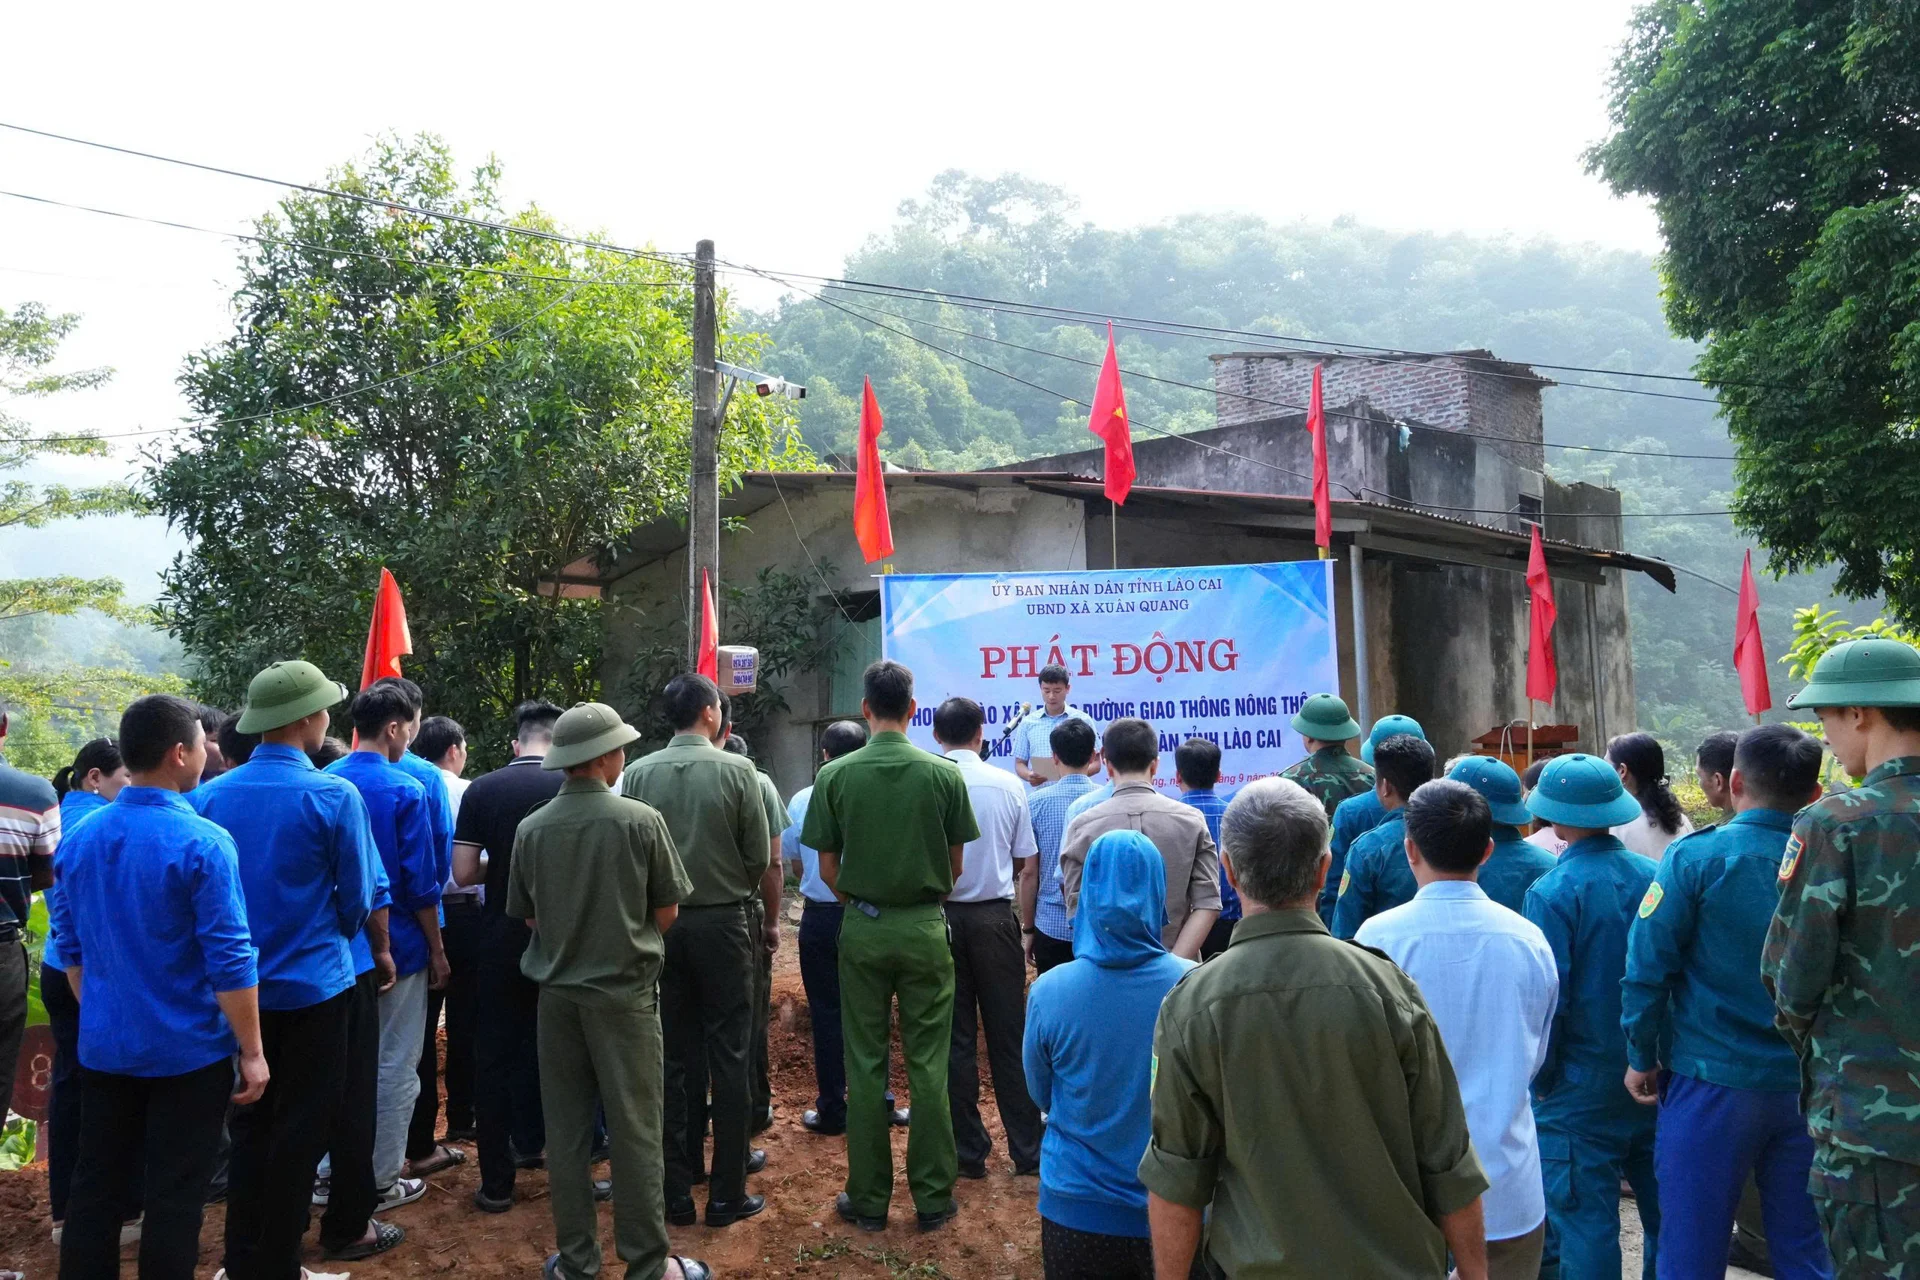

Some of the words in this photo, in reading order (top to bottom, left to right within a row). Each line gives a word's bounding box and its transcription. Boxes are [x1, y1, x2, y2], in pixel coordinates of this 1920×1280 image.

[992, 580, 1011, 597] ỦY
[1015, 585, 1045, 596] BAN
[1048, 580, 1090, 596] NHÂN
[1094, 579, 1124, 595] DÂN
[1128, 577, 1164, 594] TỈNH
[1167, 577, 1195, 592] LÀO
[1198, 578, 1222, 590] CAI
[1026, 603, 1066, 616] UBND
[1070, 600, 1091, 614] XÃ
[1095, 598, 1136, 614] XUÂN
[1139, 598, 1190, 613] QUANG
[979, 633, 1098, 679] PHÁT
[1110, 630, 1239, 684] ĐỘNG
[1140, 700, 1176, 720] GIAO
[1180, 695, 1231, 718] THÔNG
[1235, 693, 1277, 717] NÔNG
[1281, 691, 1309, 715] THÔ
[1223, 726, 1252, 750] LÀO
[1256, 729, 1282, 749] CAI
[1238, 773, 1244, 783] 9
